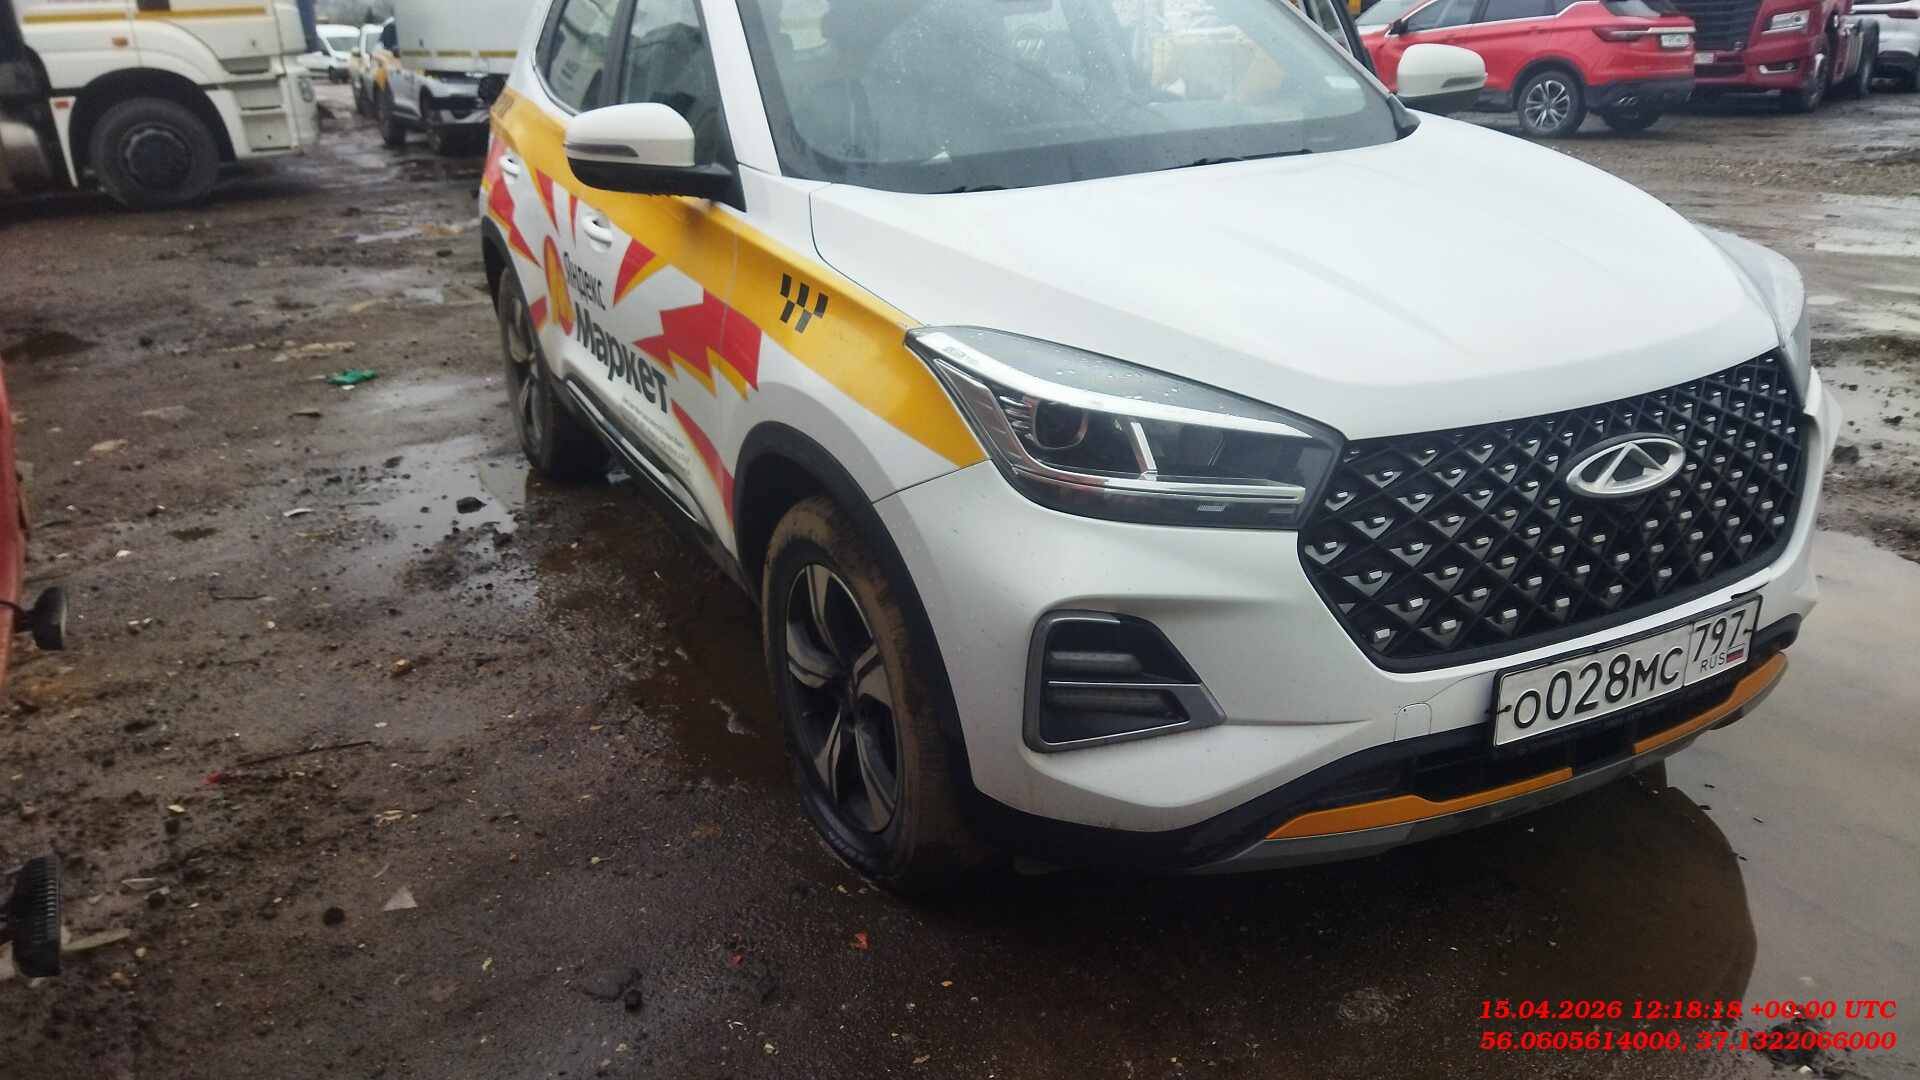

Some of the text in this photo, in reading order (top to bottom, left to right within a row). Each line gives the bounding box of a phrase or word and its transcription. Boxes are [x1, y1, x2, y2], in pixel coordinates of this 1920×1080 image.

[575, 302, 668, 414] Маркет
[1693, 610, 1747, 663] 797
[1700, 653, 1728, 674] RUS
